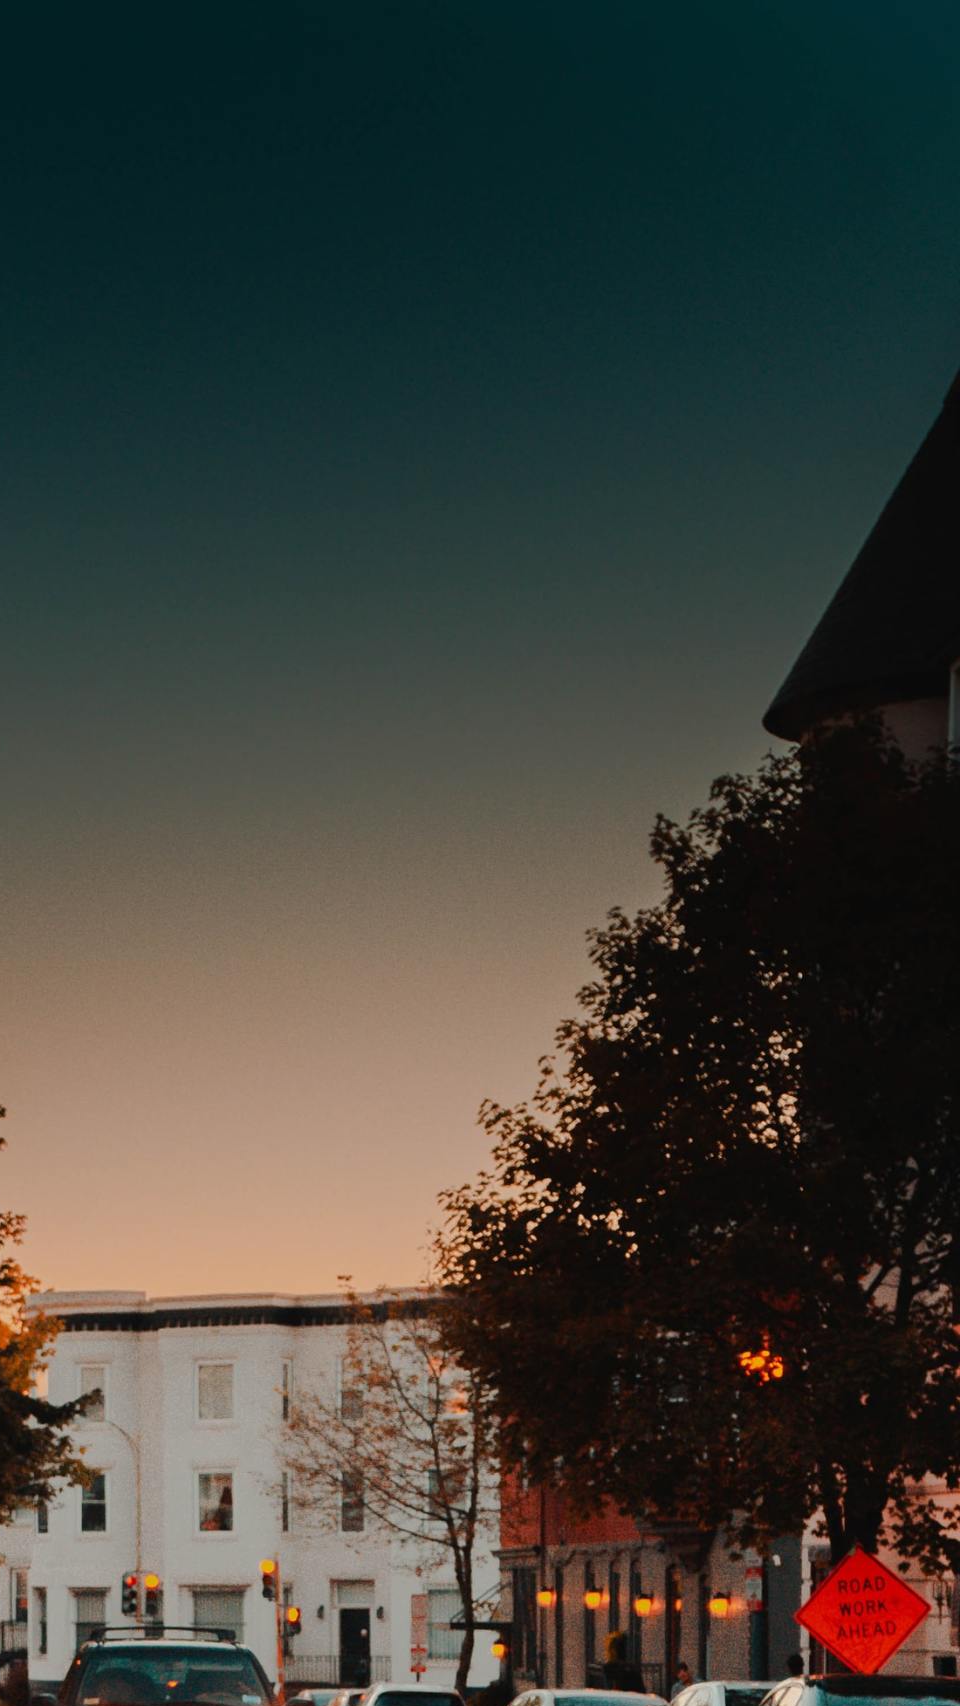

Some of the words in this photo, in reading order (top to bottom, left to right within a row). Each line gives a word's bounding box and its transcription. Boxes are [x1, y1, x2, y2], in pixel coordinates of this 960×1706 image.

[837, 1576, 886, 1594] ROAD
[838, 1599, 888, 1617] WORK
[836, 1620, 897, 1640] AHEAD
